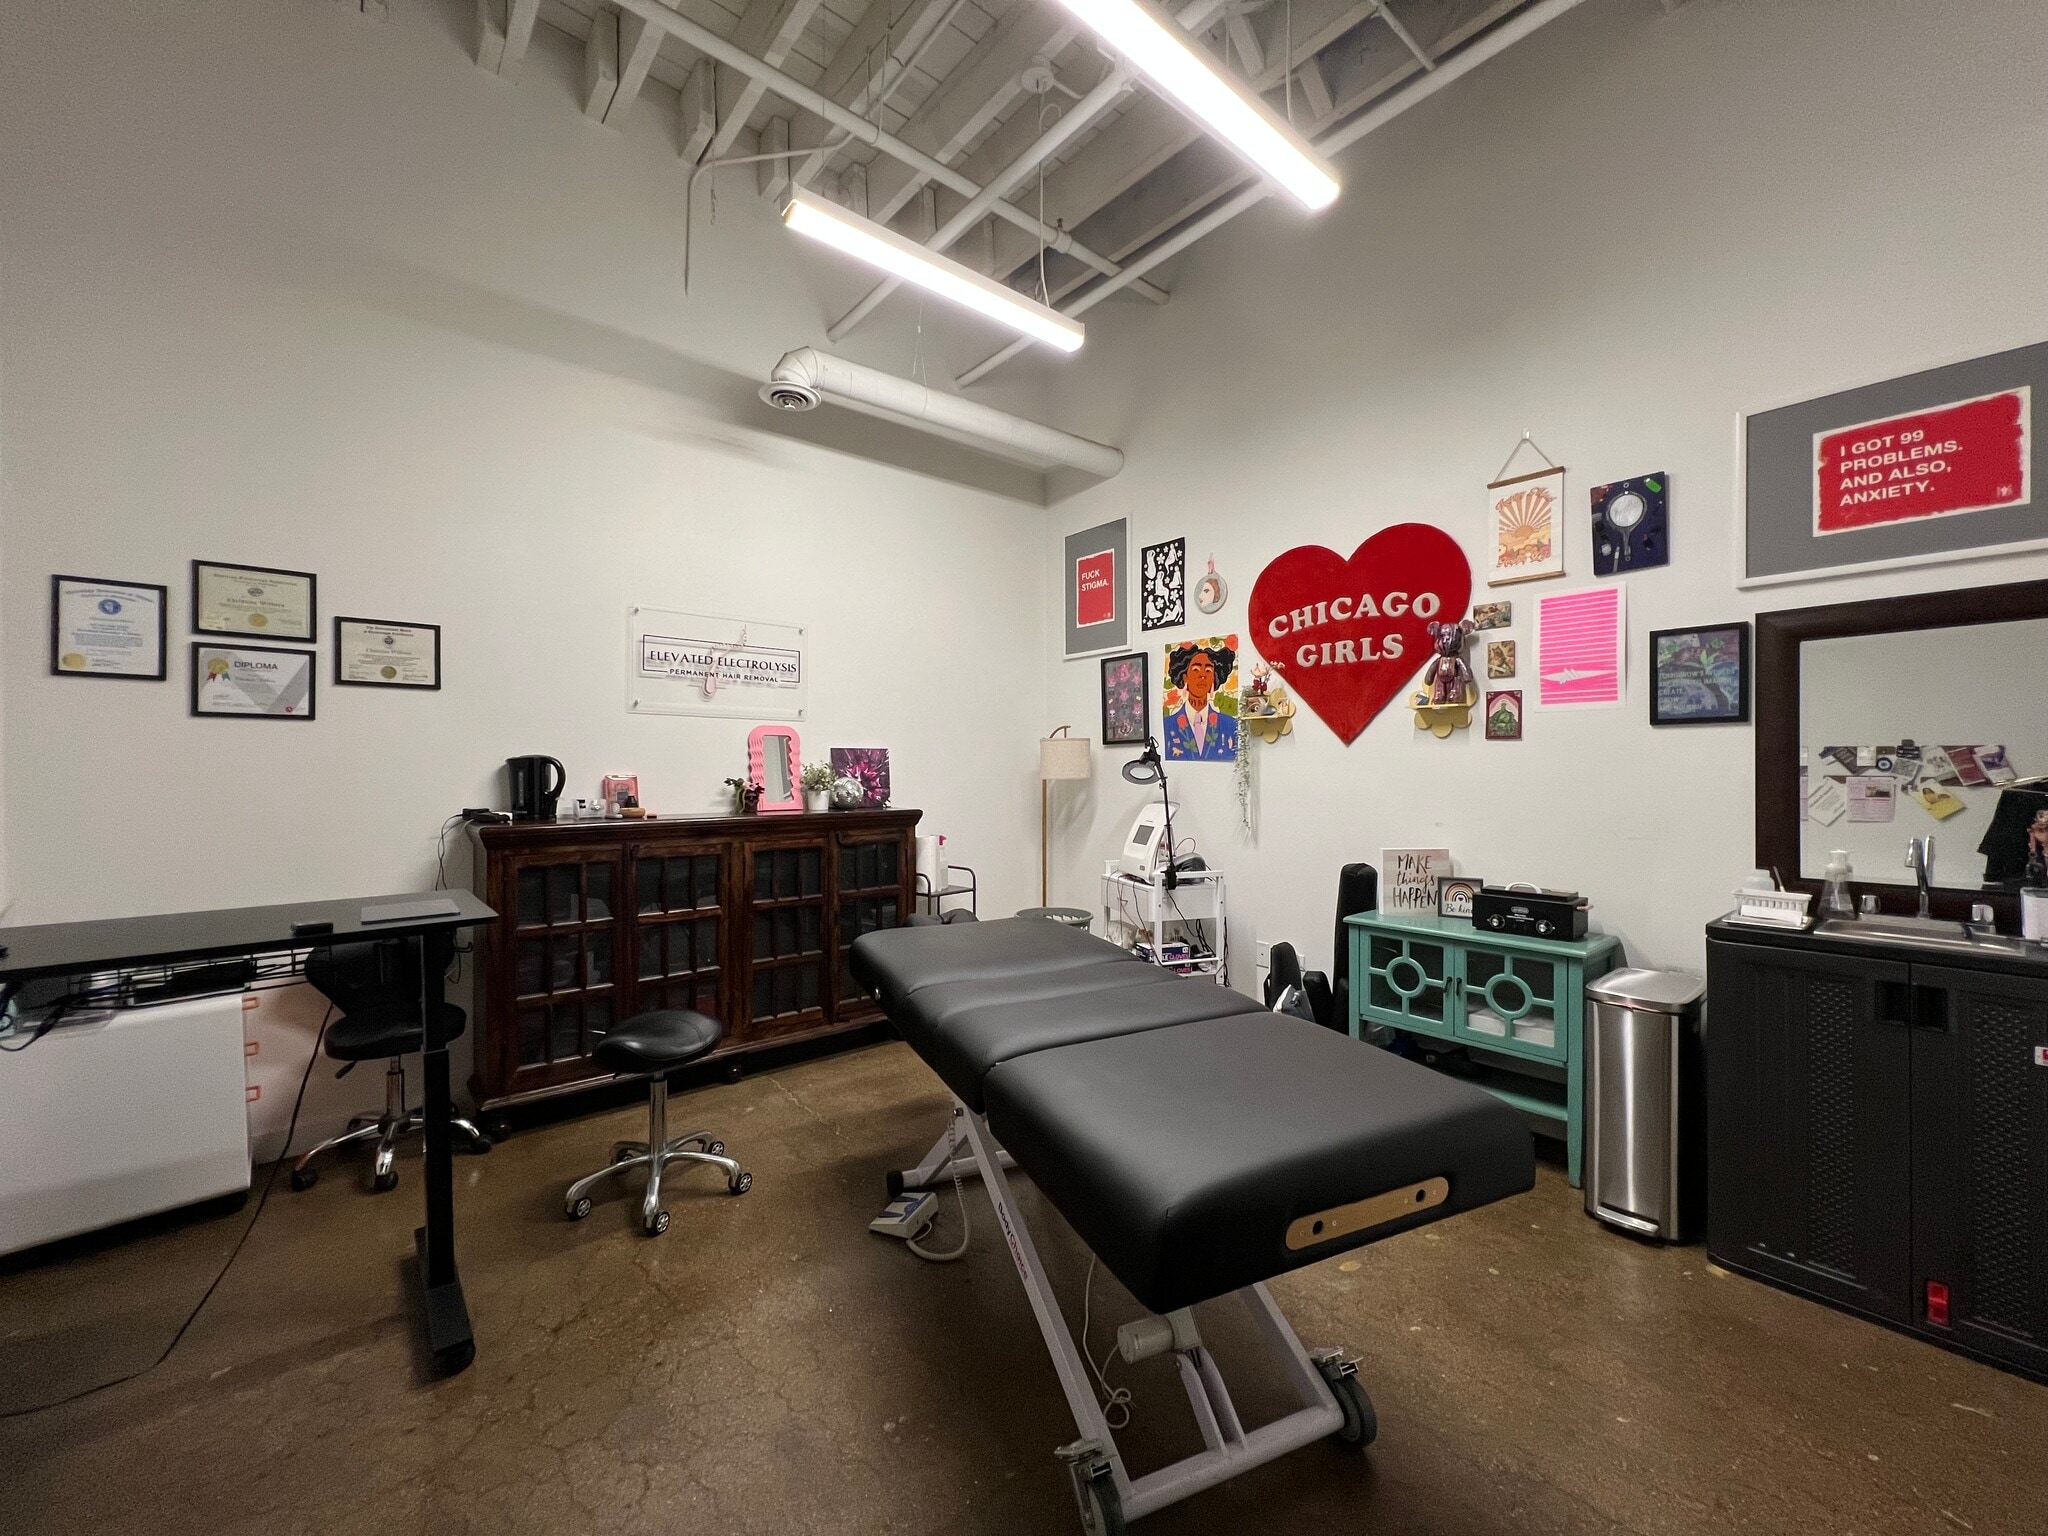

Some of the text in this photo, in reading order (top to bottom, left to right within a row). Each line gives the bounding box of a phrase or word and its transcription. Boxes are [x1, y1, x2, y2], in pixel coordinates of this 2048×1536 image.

[1840, 429, 1925, 457] I GOT 99
[1840, 440, 1963, 473] PROBLEMS.
[1839, 460, 1951, 490] AND ALSO,
[1839, 480, 1935, 507] ANXIETY.
[1081, 569, 1100, 580] FUCK
[1081, 579, 1109, 591] STIGMA.
[1268, 591, 1441, 638] CHICAGO
[1296, 633, 1404, 667] GIRLS
[234, 661, 278, 670] DIPLOMA
[650, 650, 797, 673] ELEVATED ELECTROLYSIS
[669, 668, 719, 679] PERMANENT
[744, 674, 779, 683] REMOVAL
[1397, 853, 1432, 874] MAKE
[1397, 872, 1435, 894] things
[1393, 887, 1438, 909] HAPPEN
[1445, 903, 1456, 913] Be
